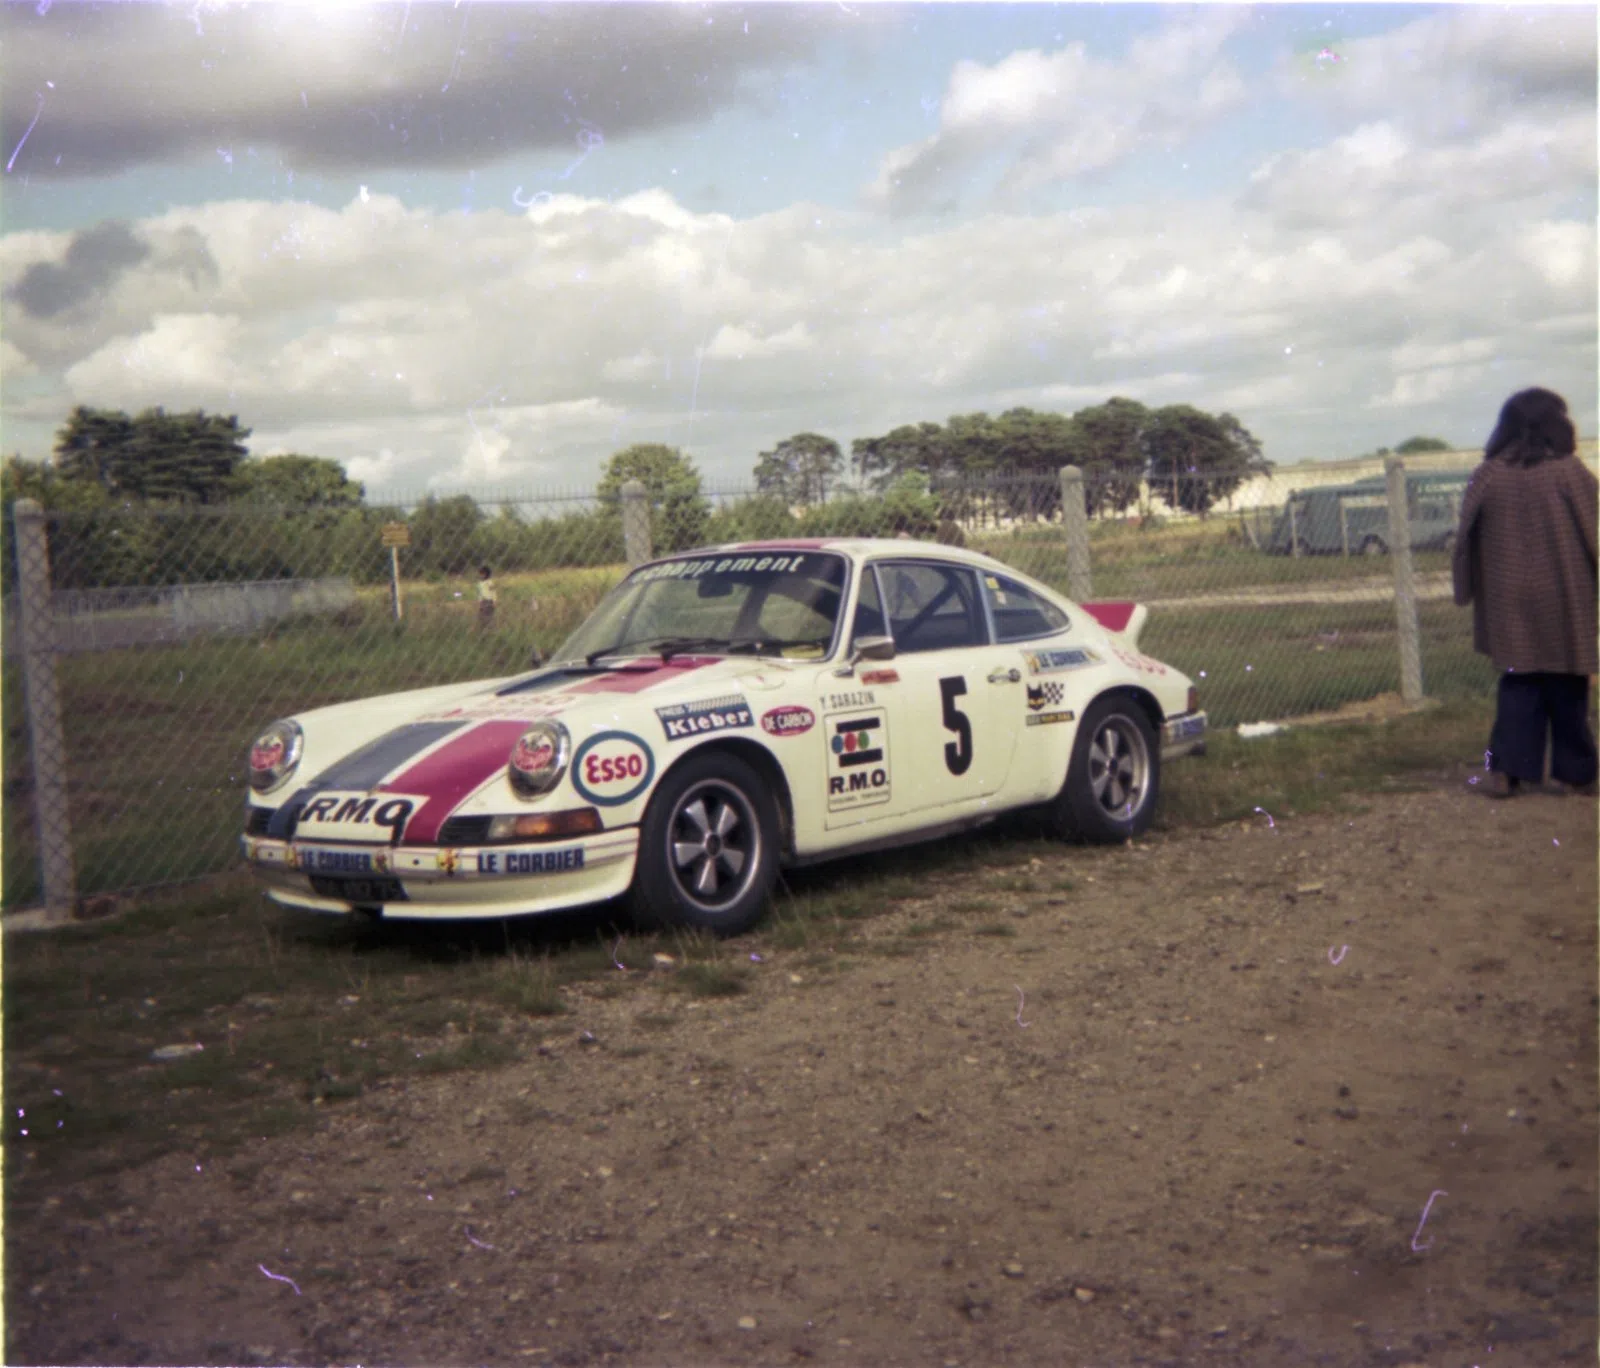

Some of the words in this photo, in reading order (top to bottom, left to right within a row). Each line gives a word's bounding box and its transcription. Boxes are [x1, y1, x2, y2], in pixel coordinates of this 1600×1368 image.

[666, 710, 750, 737] Kleber
[939, 675, 974, 777] 5
[829, 769, 890, 795] R.M.O.
[477, 853, 498, 873] LE
[505, 848, 585, 873] CORBIER
